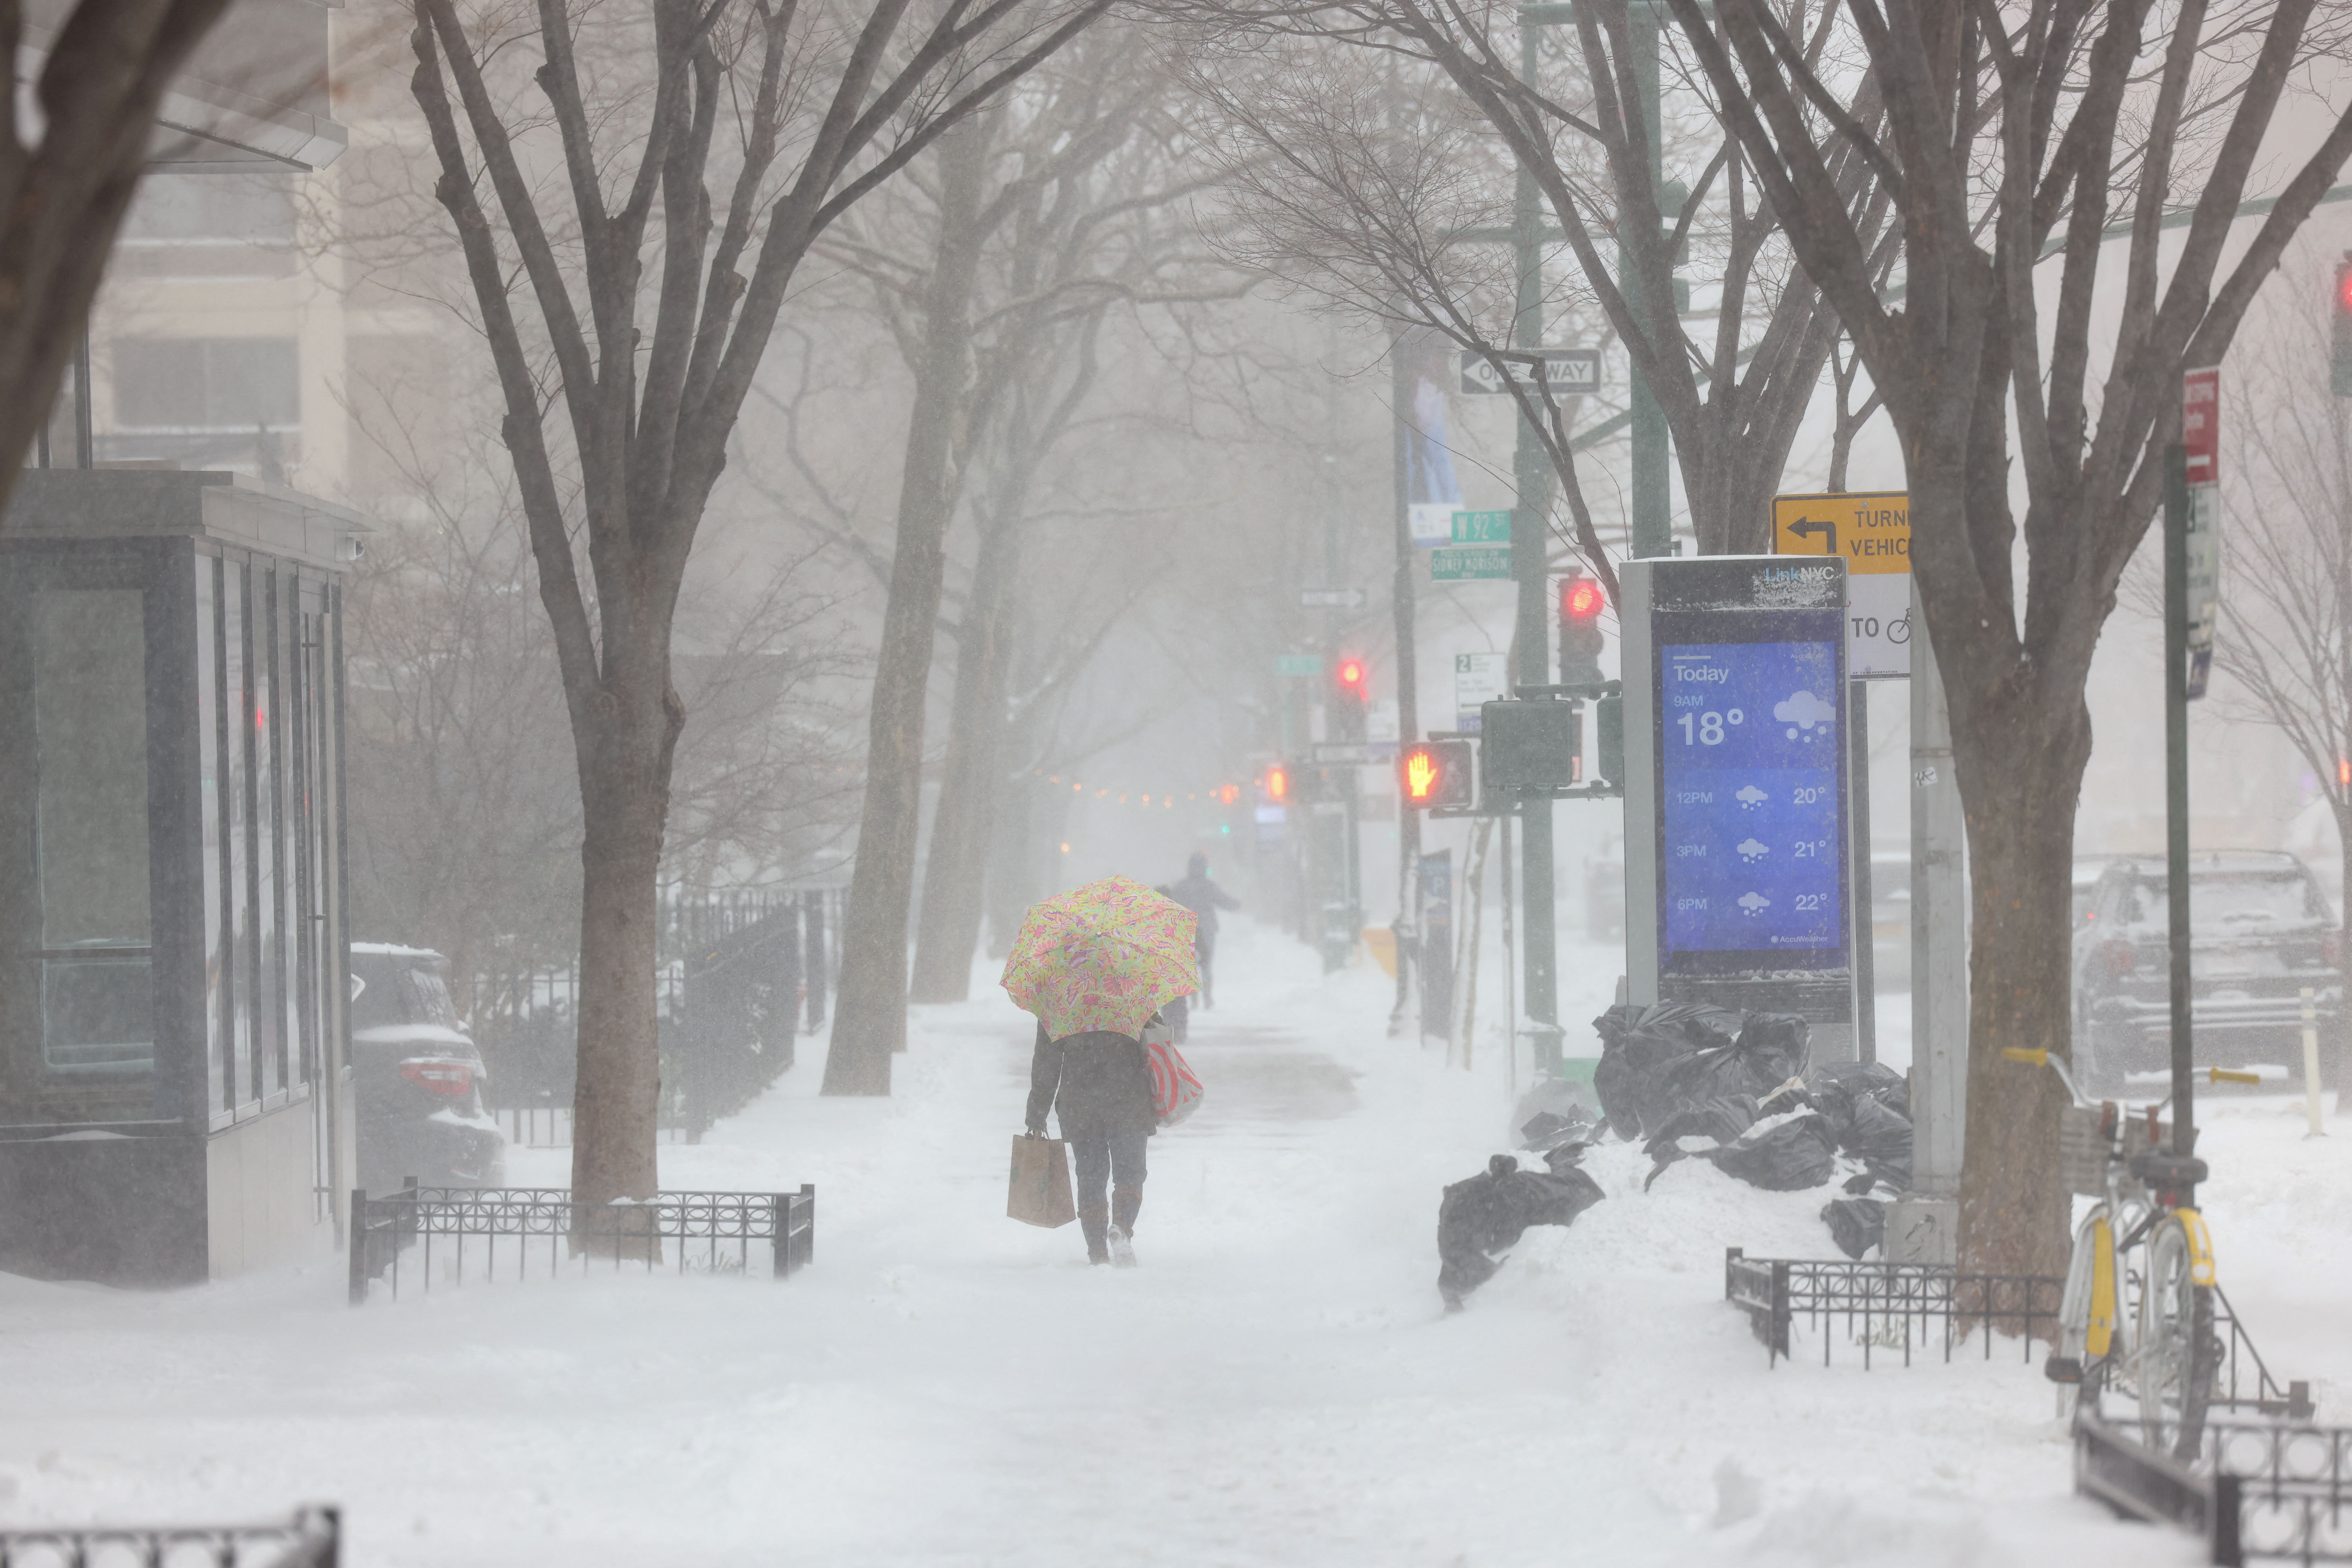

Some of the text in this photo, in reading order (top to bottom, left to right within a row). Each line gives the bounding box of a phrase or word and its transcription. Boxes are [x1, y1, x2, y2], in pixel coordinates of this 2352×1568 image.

[1545, 362, 1587, 380] WAY
[1457, 515, 1468, 540] W
[1473, 513, 1489, 539] 92
[1850, 538, 1910, 556] VEHIC
[1765, 567, 1834, 581] LinkNYC
[1851, 618, 1879, 638] TO
[1459, 656, 1468, 671] 2
[1673, 665, 1729, 684] Today
[1674, 695, 1704, 707] 9AM
[1677, 709, 1744, 745] 18°
[1677, 786, 1826, 804] 12PM 20°
[1677, 840, 1826, 857] 3PM 21°
[1677, 893, 1827, 910] 6PM 22°
